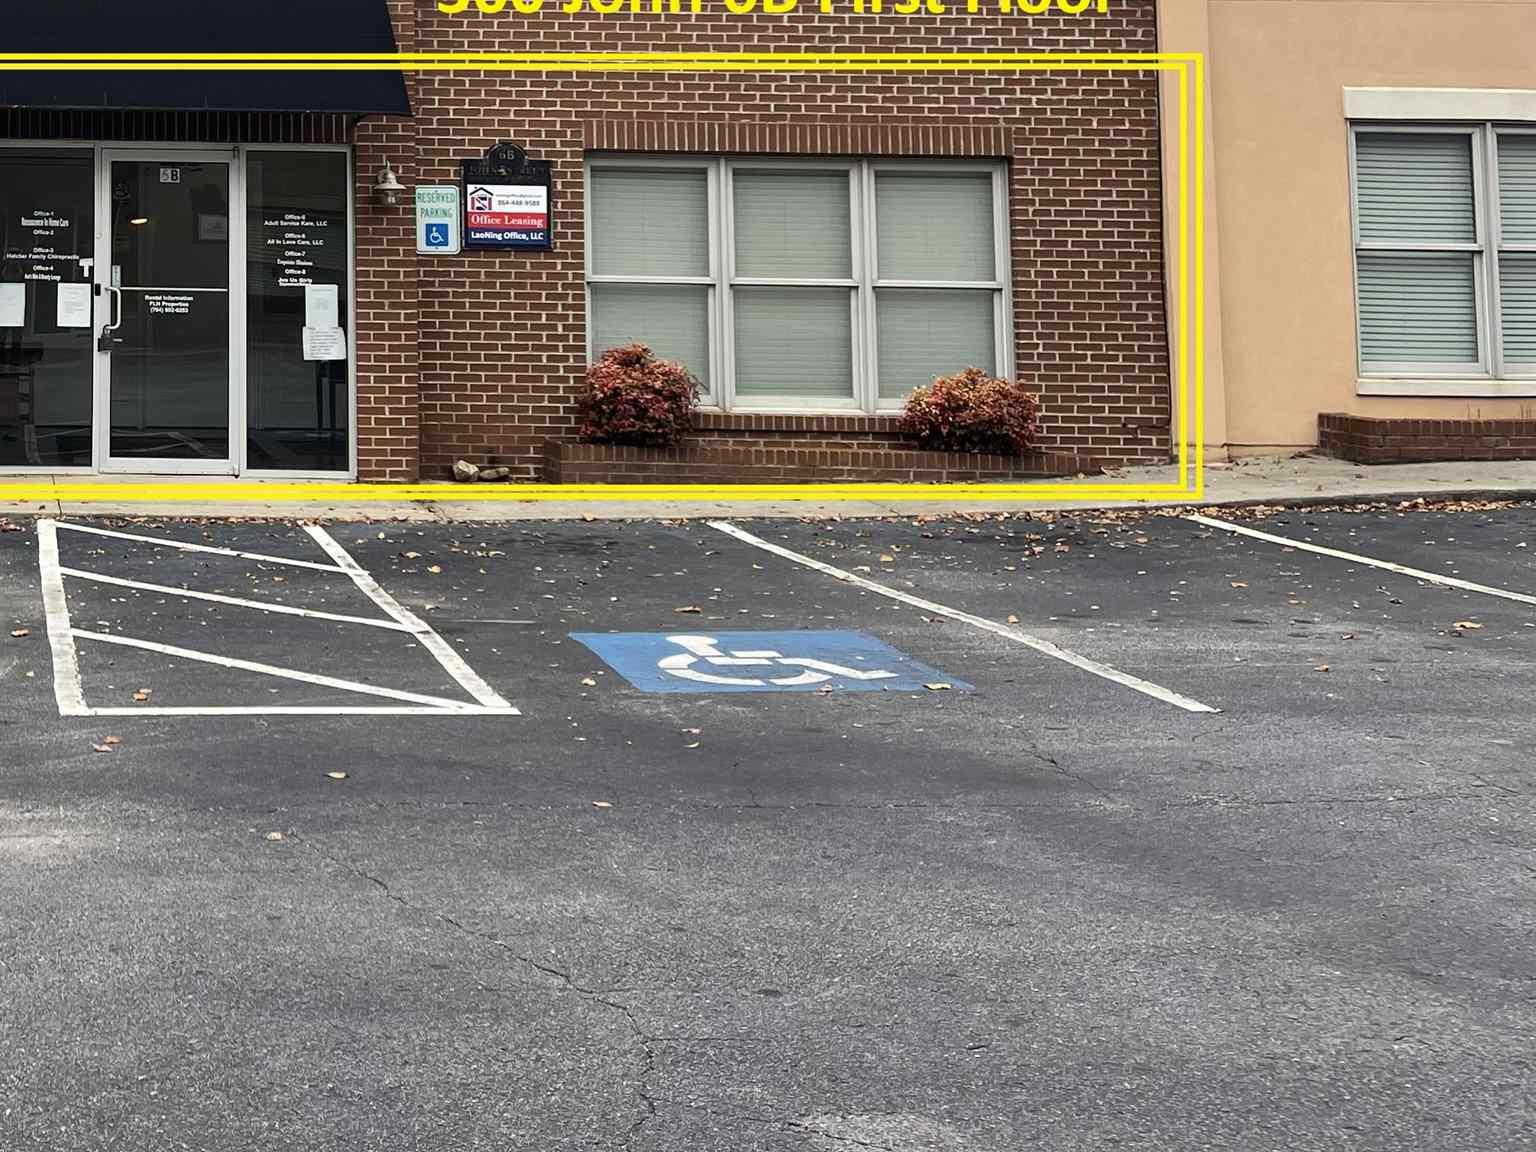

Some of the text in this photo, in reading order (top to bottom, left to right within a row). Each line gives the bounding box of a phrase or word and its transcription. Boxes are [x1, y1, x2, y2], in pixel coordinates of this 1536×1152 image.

[417, 192, 456, 204] RESERVED
[420, 207, 453, 219] PARKING
[471, 215, 544, 229] Office Leasing
[503, 231, 529, 241] Office,
[530, 232, 544, 240] LLC
